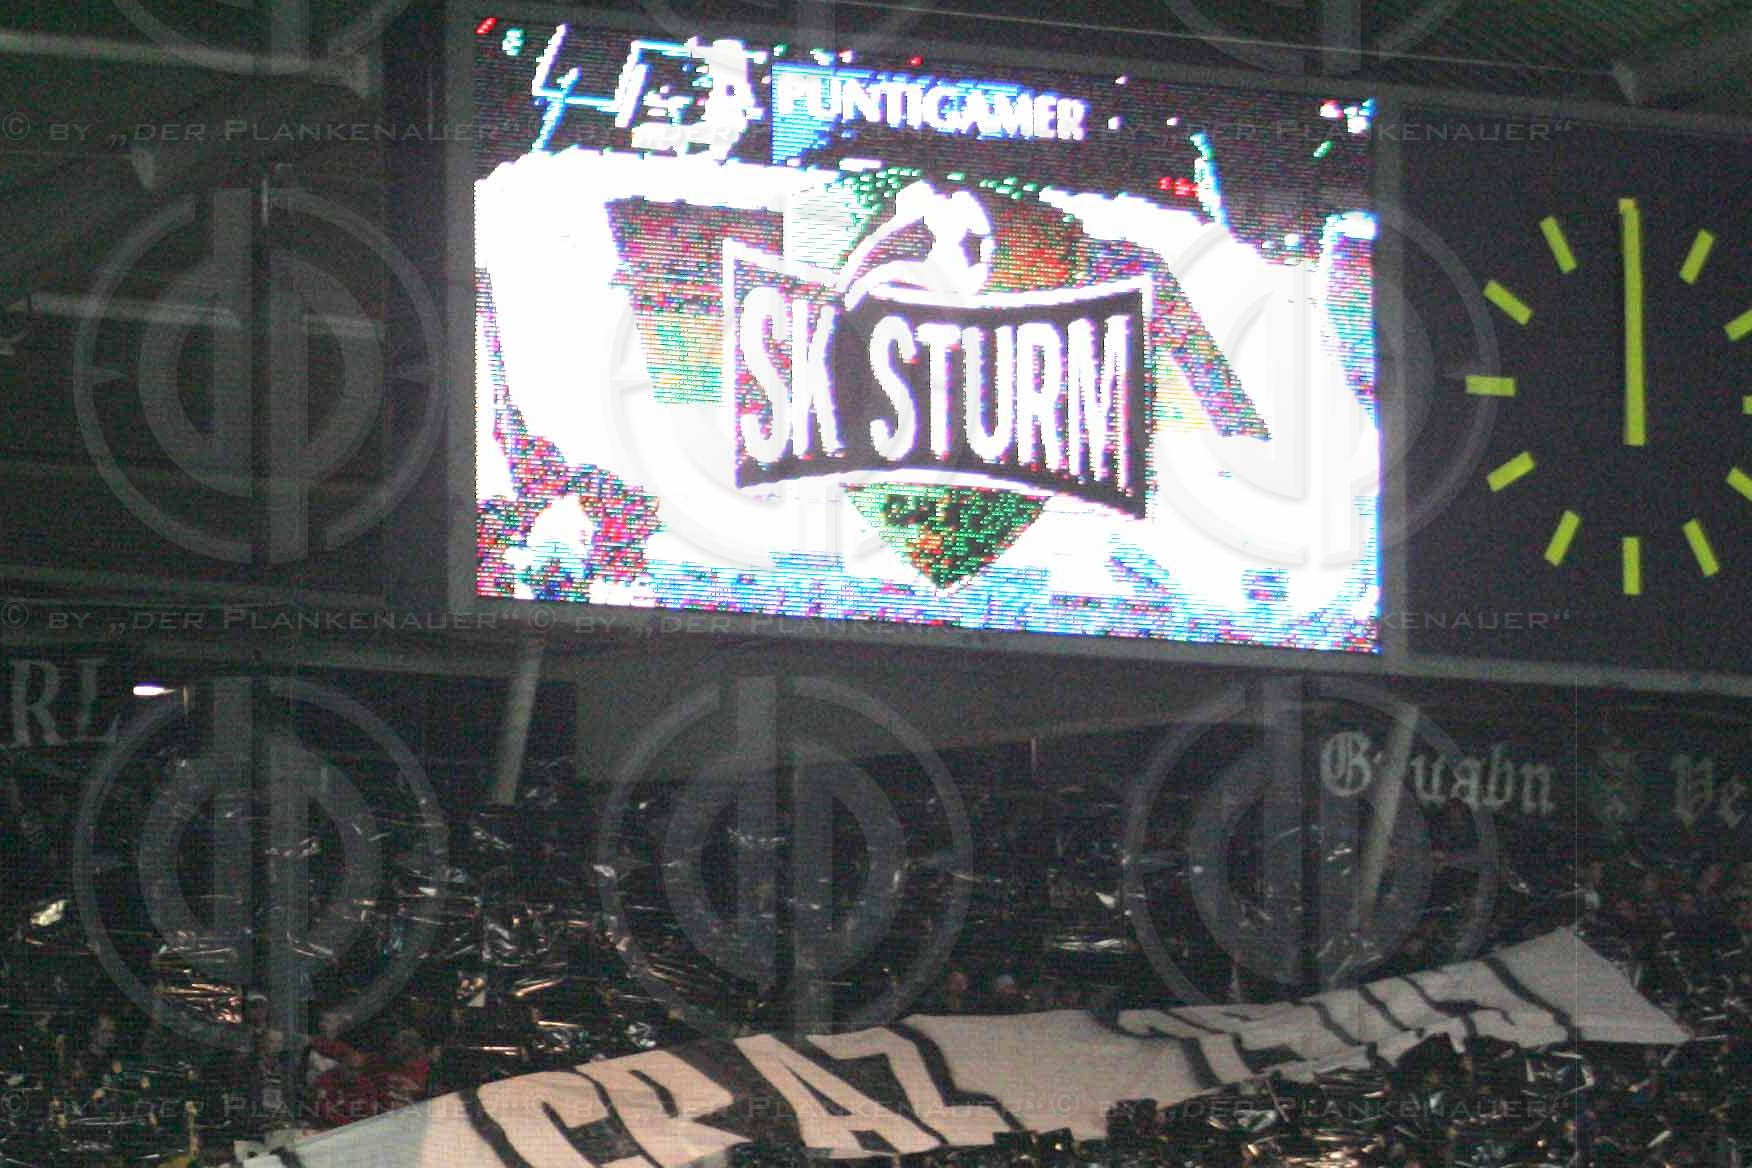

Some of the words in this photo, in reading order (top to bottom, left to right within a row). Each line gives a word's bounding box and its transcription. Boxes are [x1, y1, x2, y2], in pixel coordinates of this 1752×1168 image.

[779, 74, 1085, 142] PUNTIGAMER
[739, 285, 847, 463] SK
[868, 313, 1133, 502] STURM
